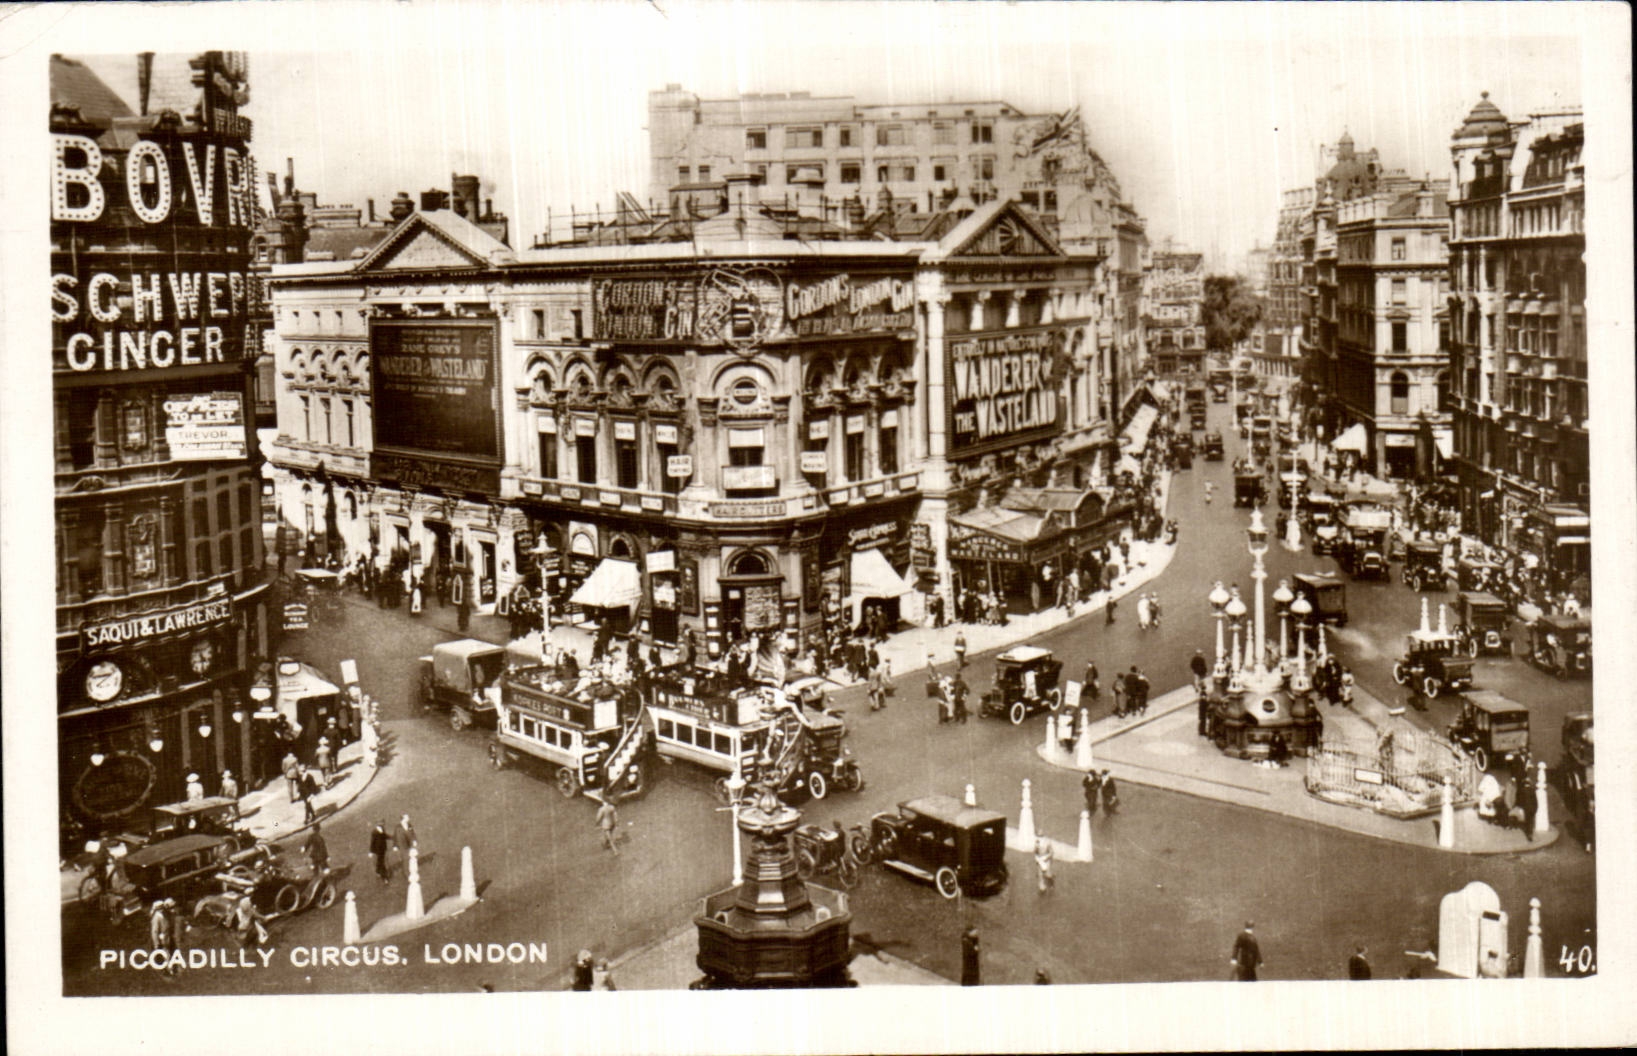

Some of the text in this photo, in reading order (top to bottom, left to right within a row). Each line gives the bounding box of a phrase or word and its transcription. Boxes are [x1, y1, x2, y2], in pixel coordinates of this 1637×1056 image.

[66, 326, 224, 372] GINGER
[429, 357, 486, 380] WASTELAND
[954, 352, 1044, 401] WANDERER
[178, 430, 228, 440] TREVOR
[955, 390, 1056, 440] THE WASTELAND
